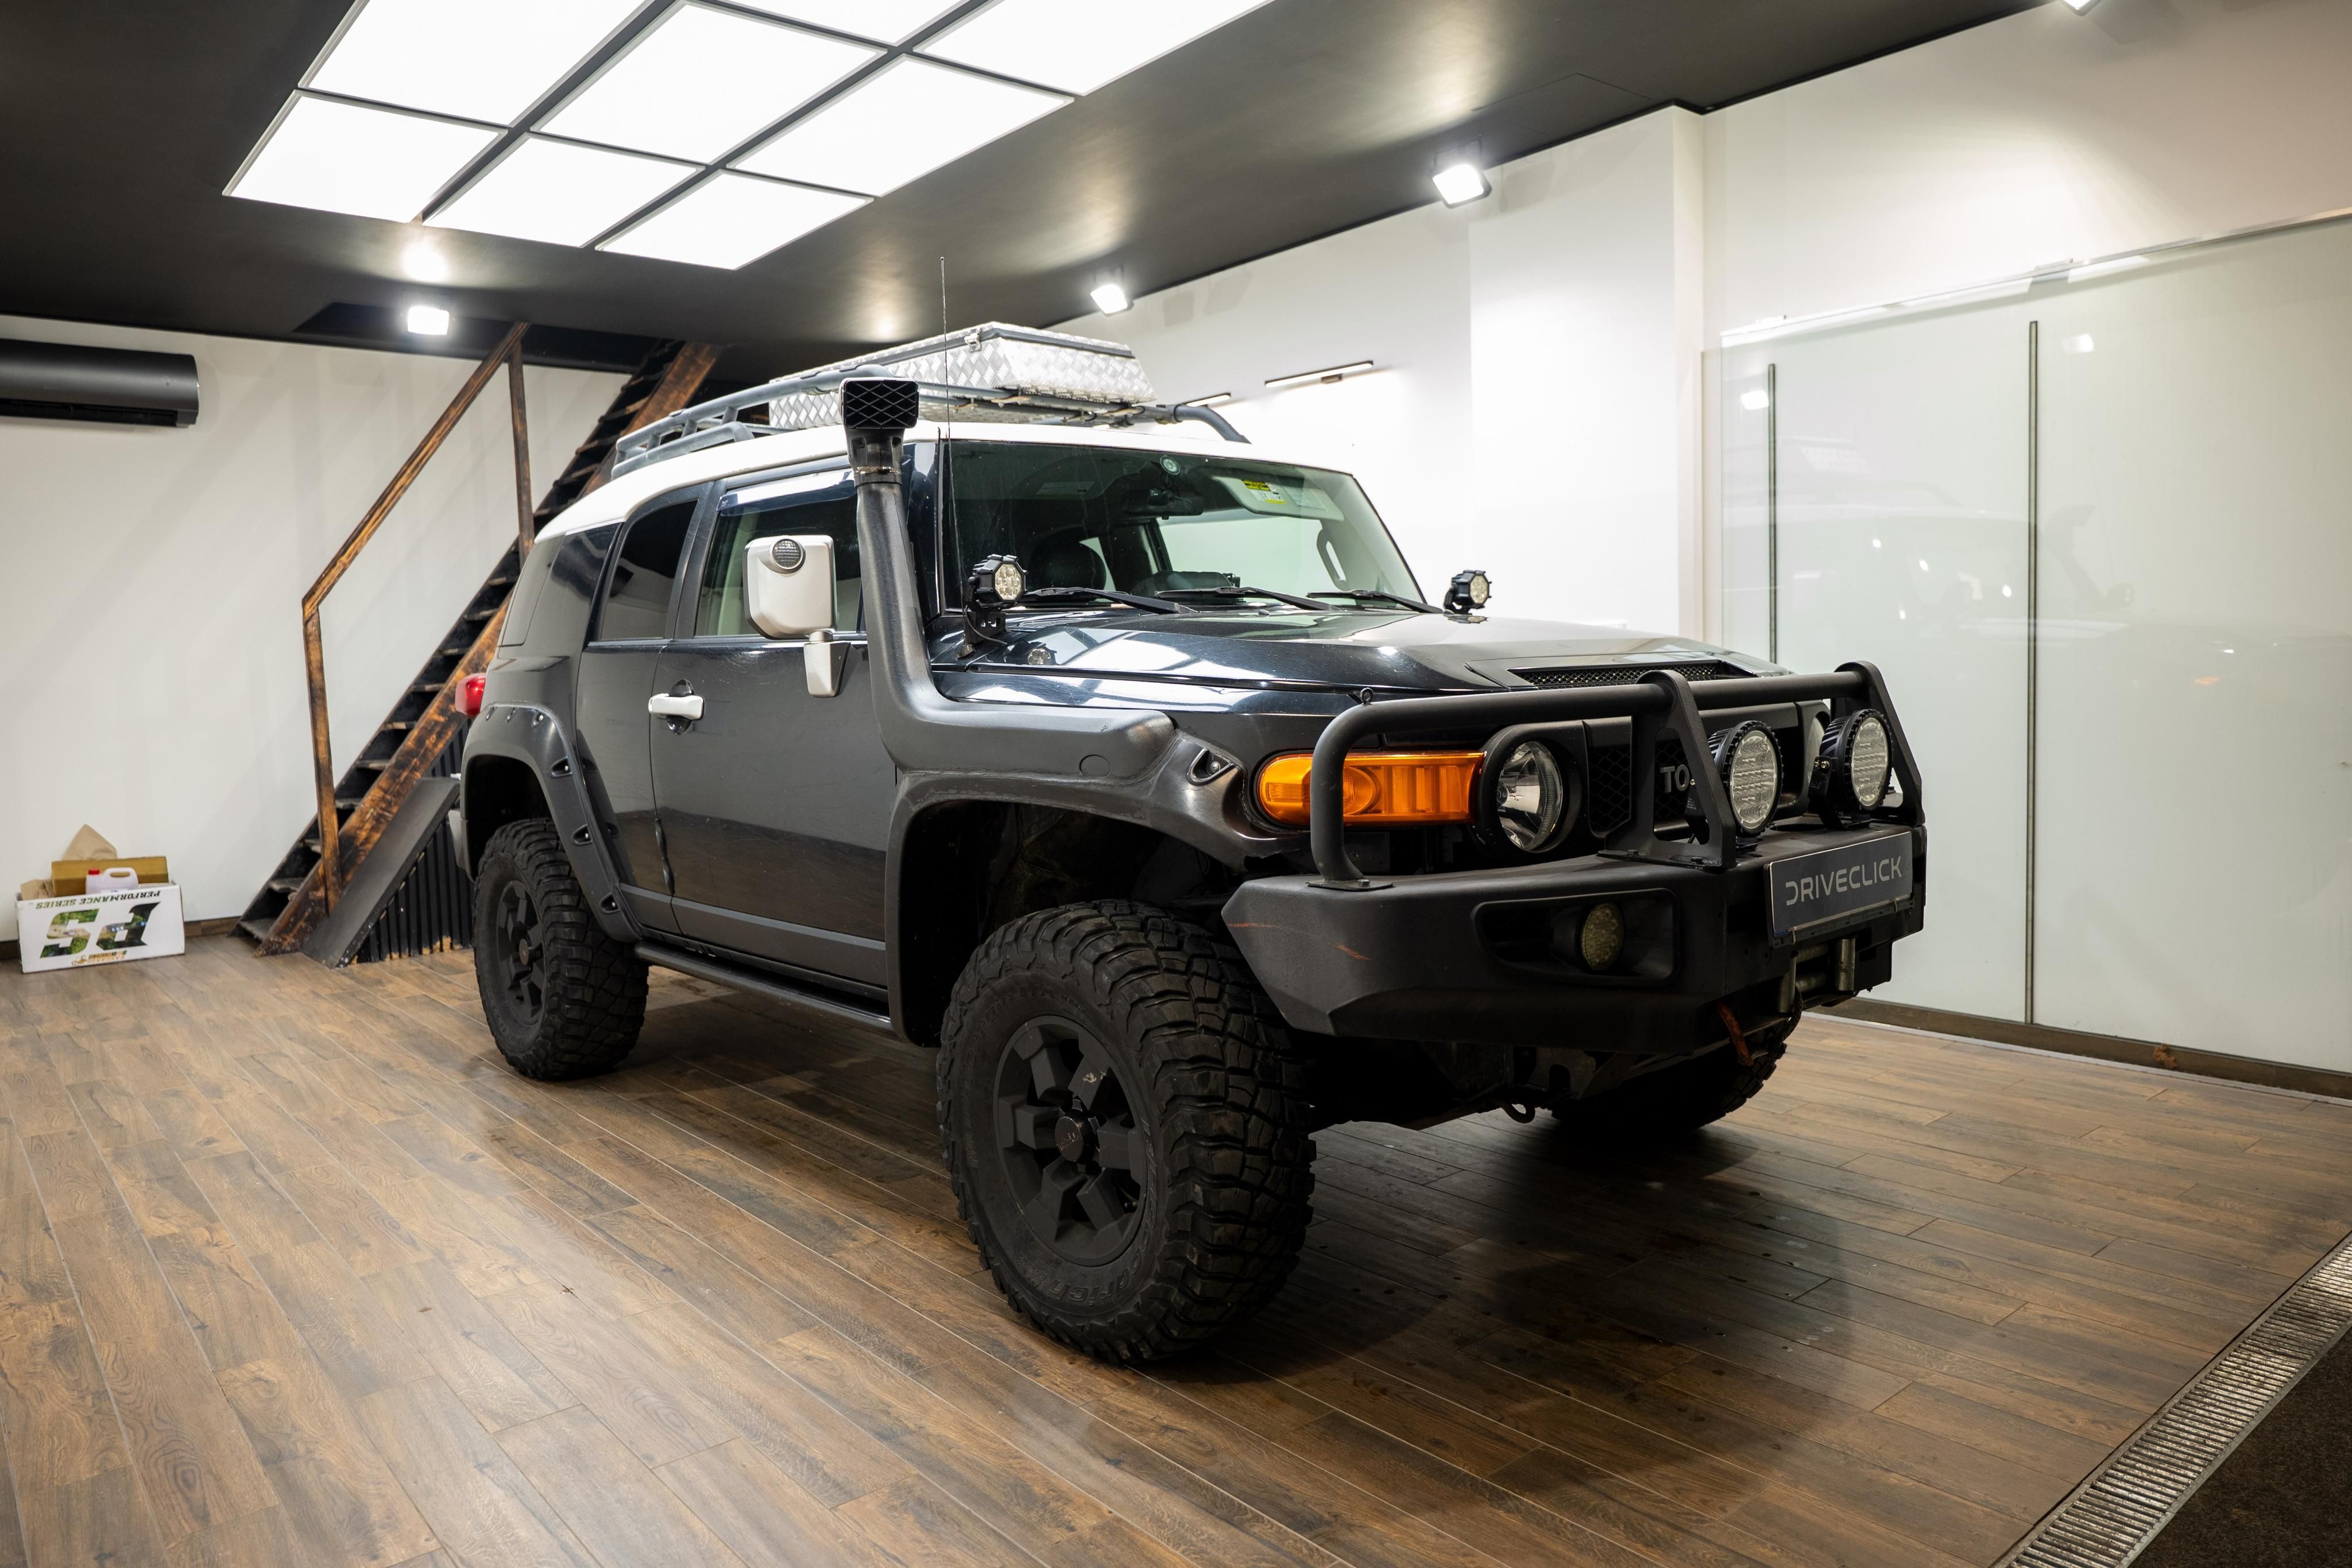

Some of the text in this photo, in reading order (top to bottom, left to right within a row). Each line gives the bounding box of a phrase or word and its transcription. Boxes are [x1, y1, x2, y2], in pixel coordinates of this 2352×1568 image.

[36, 891, 161, 909] PERFORMANCE SERIES
[1785, 856, 1902, 906] DRIVECLICK
[40, 901, 161, 958] PS
